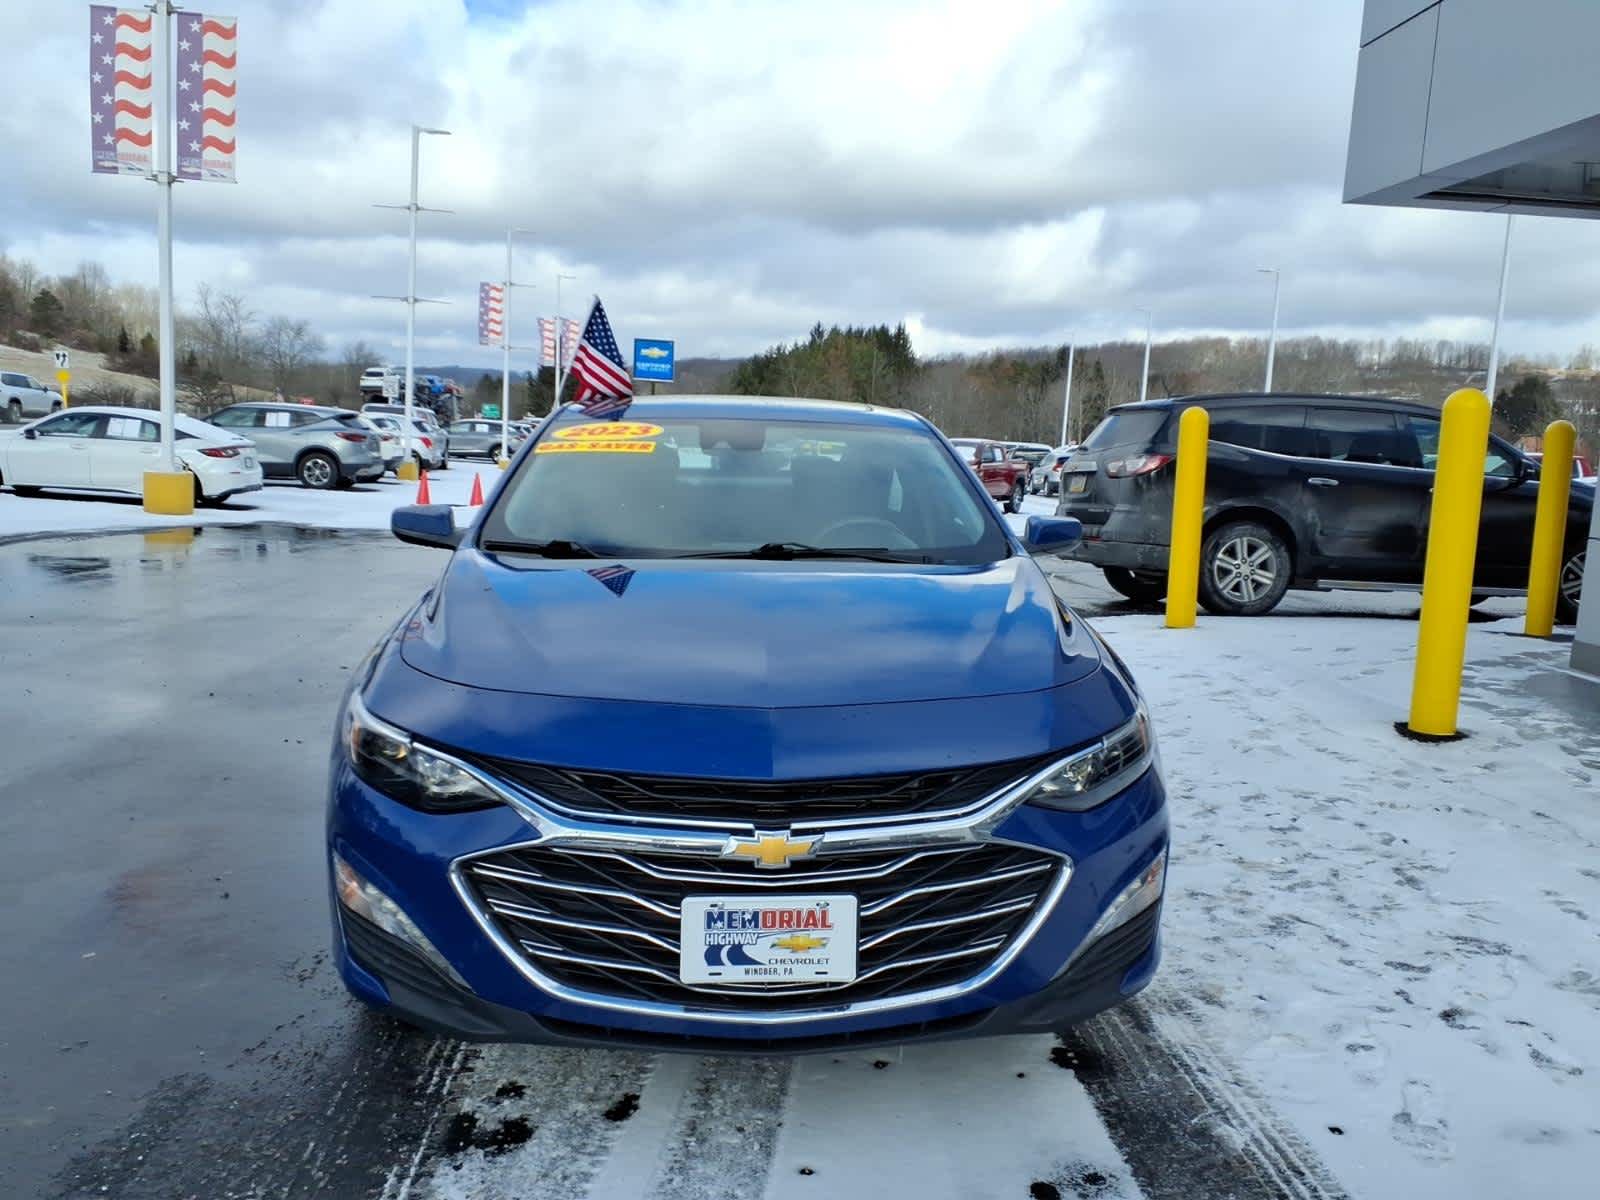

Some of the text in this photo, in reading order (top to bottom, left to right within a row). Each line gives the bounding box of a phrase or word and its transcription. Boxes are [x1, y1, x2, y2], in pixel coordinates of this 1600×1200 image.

[563, 426, 653, 437] 2023
[704, 909, 833, 930] MEMORIAL
[704, 932, 759, 945] HIGHWAY
[783, 967, 793, 975] PA
